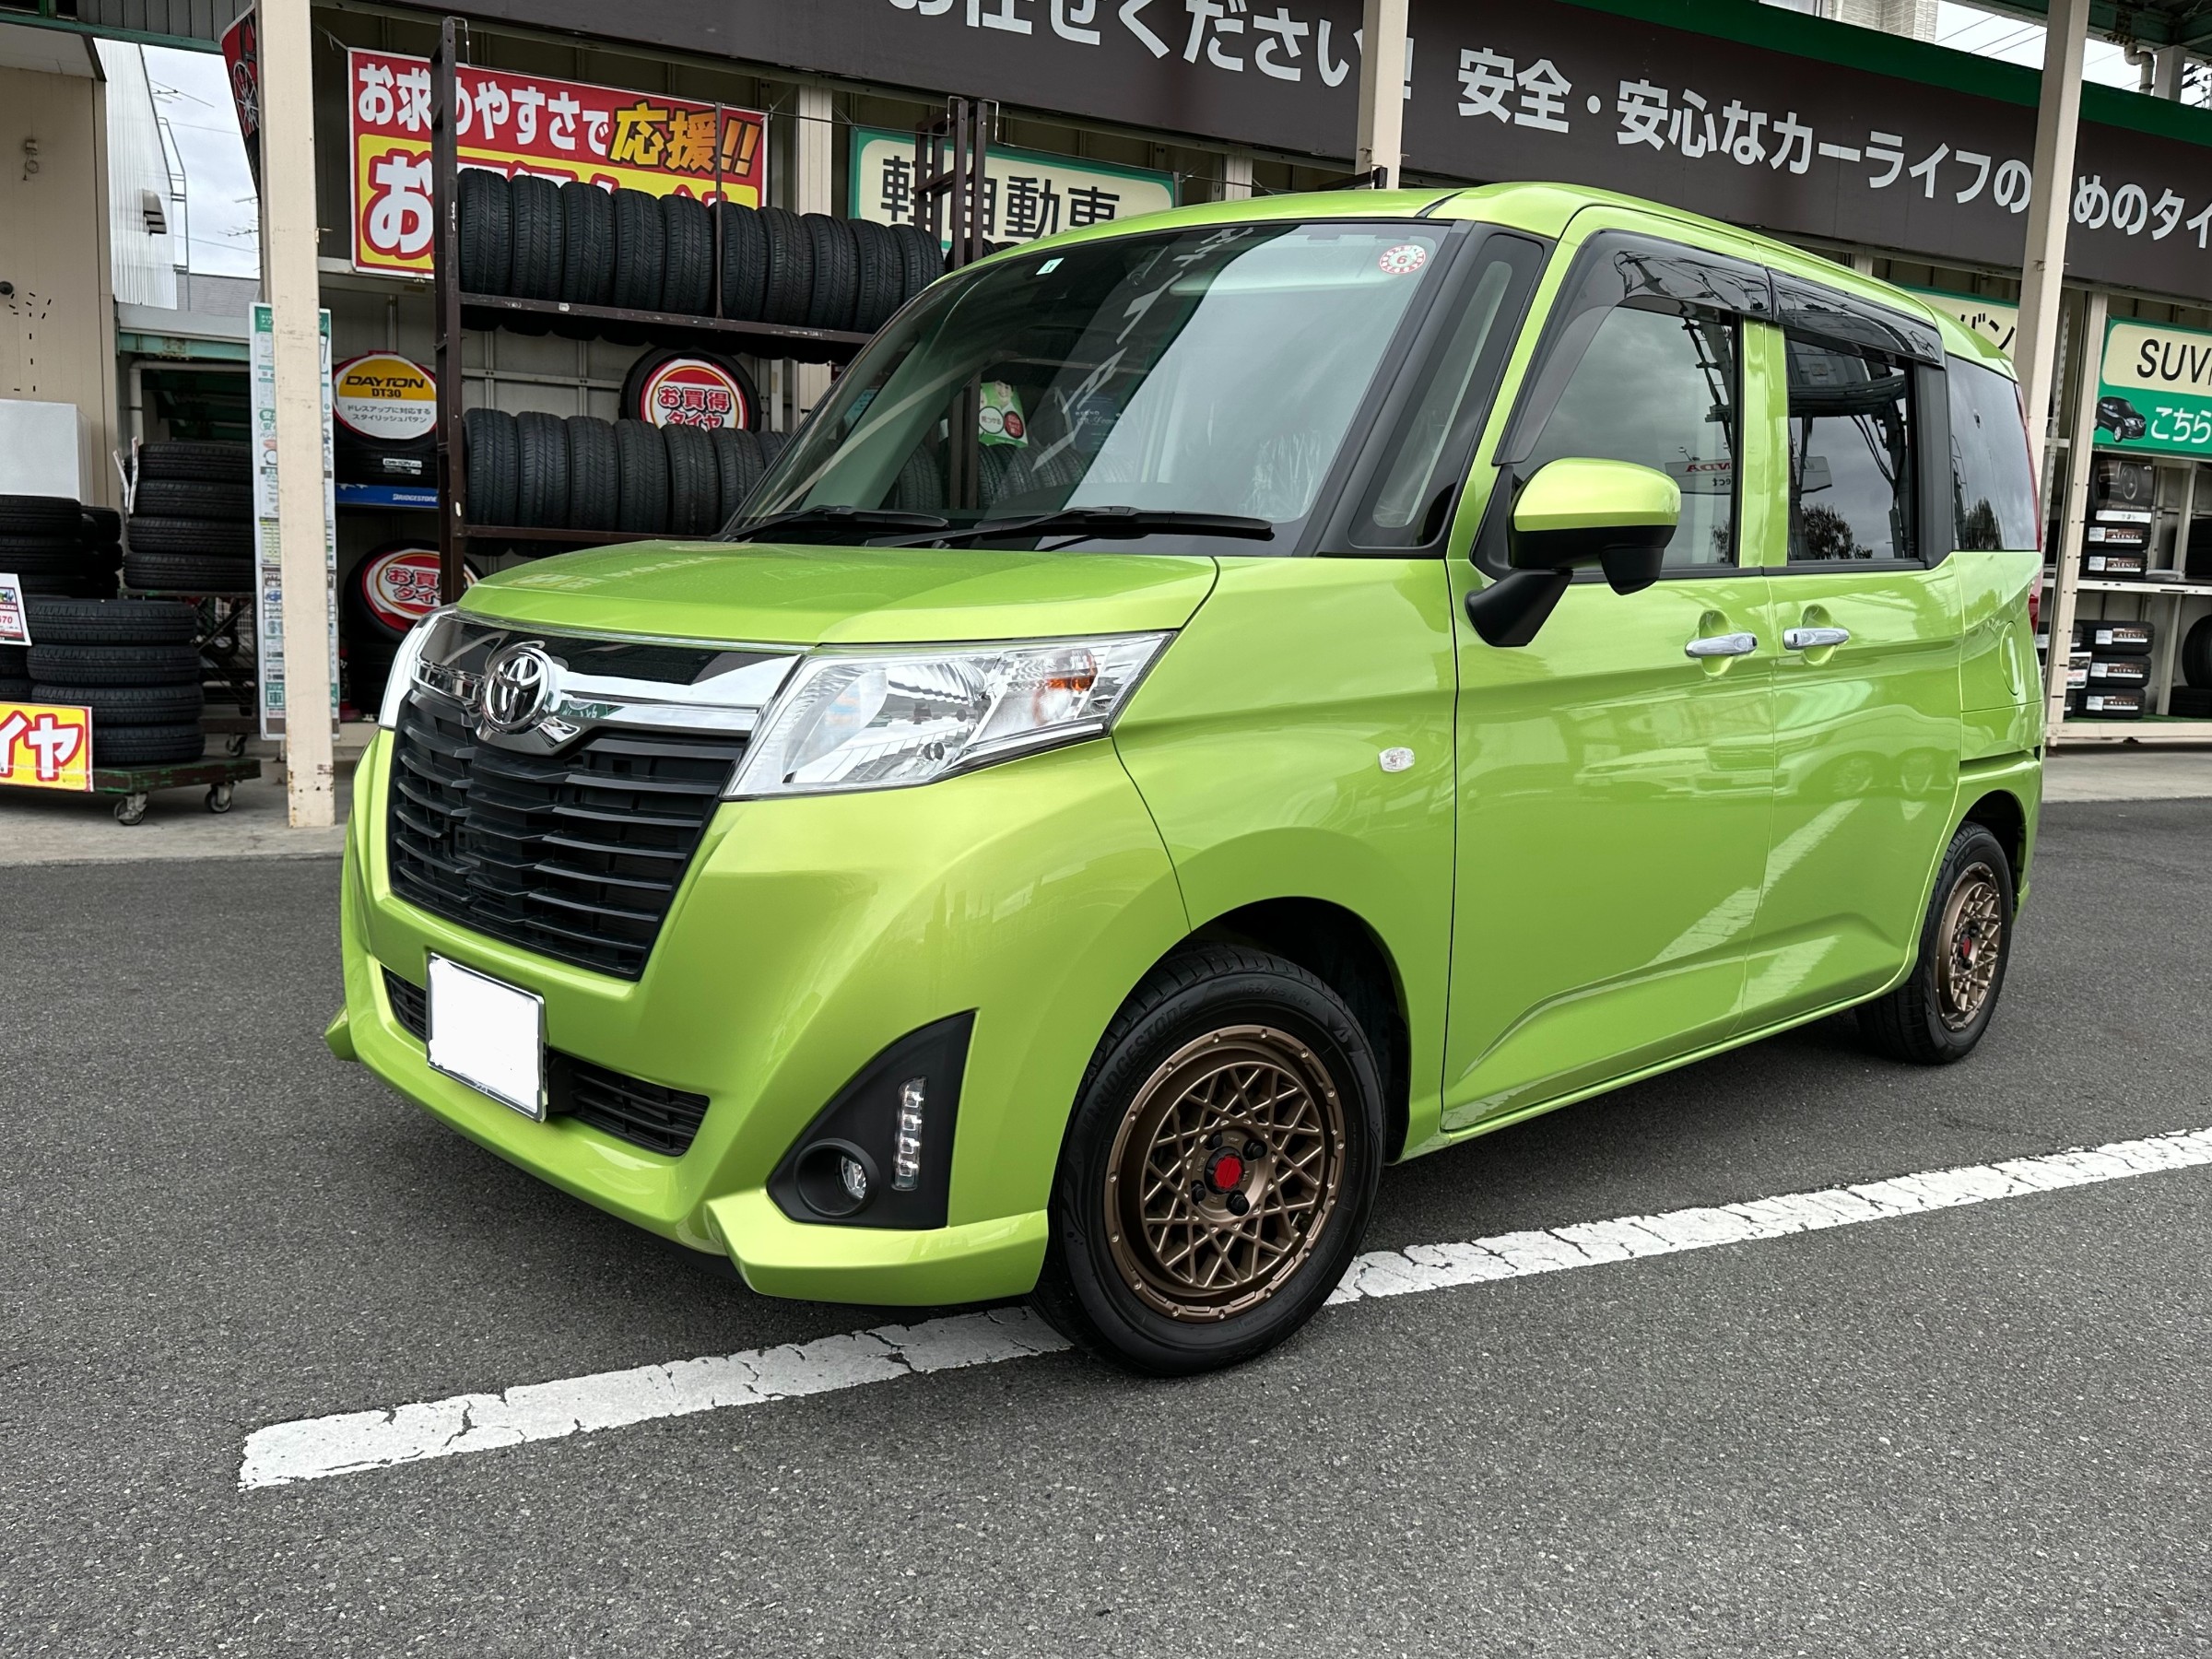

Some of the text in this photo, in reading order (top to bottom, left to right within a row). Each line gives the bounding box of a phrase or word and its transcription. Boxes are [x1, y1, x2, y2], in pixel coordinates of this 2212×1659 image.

[1457, 47, 2212, 249] 安全・安心なカーライフのめのタイ
[2136, 338, 2212, 386] SUV
[347, 375, 425, 388] DAYTON
[371, 387, 402, 398] DT30
[659, 386, 731, 415] お買得
[347, 404, 431, 416] ドレスアップに対応する
[351, 413, 428, 424] スタイリッシュパタン
[2150, 406, 2212, 444] こちら
[386, 568, 441, 589] お買
[394, 585, 441, 605] タイ
